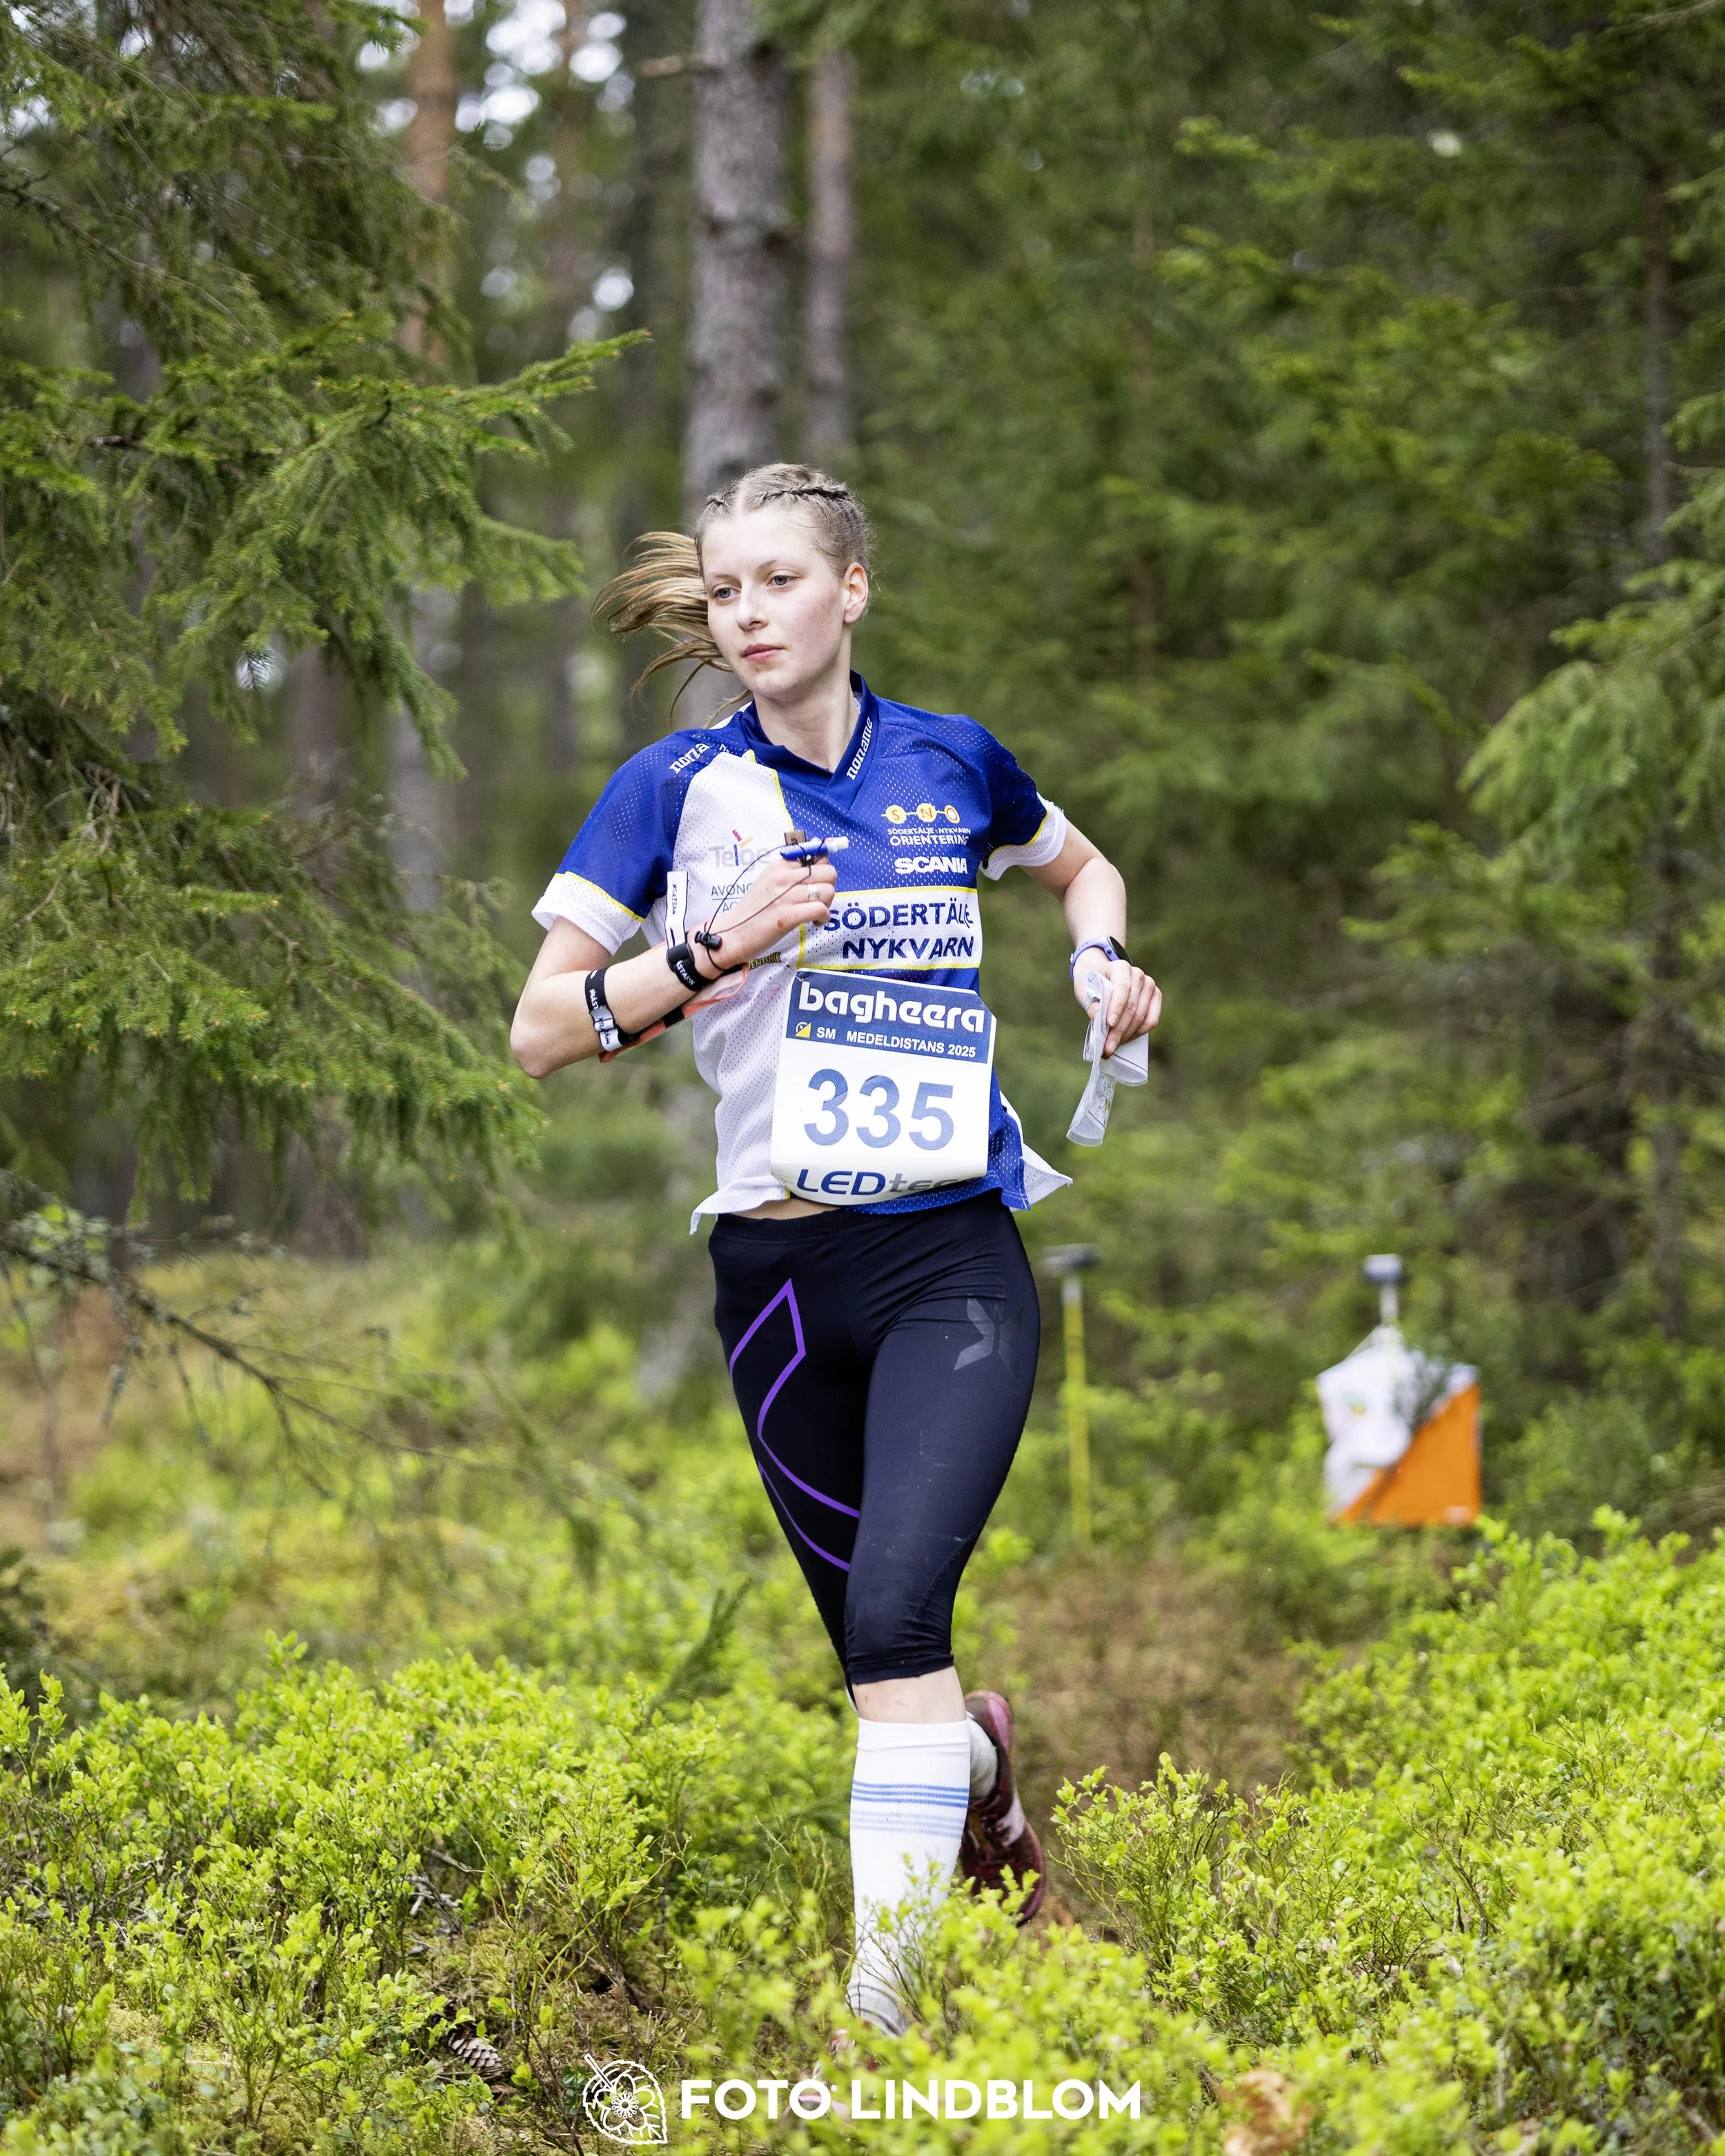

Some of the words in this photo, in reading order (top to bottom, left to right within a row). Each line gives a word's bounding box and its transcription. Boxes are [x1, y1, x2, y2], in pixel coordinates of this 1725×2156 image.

[669, 743, 729, 774] nona
[846, 716, 873, 780] noname
[889, 834, 969, 847] ORIENTERING
[708, 844, 771, 872] Telge
[894, 856, 968, 874] SCANIA
[842, 936, 974, 960] NYKVARN
[799, 981, 985, 1034] bagheera
[816, 1027, 836, 1040] SM
[846, 1031, 945, 1054] MEDELDISTANS
[947, 1044, 976, 1058] 2025
[804, 1068, 954, 1151] 335
